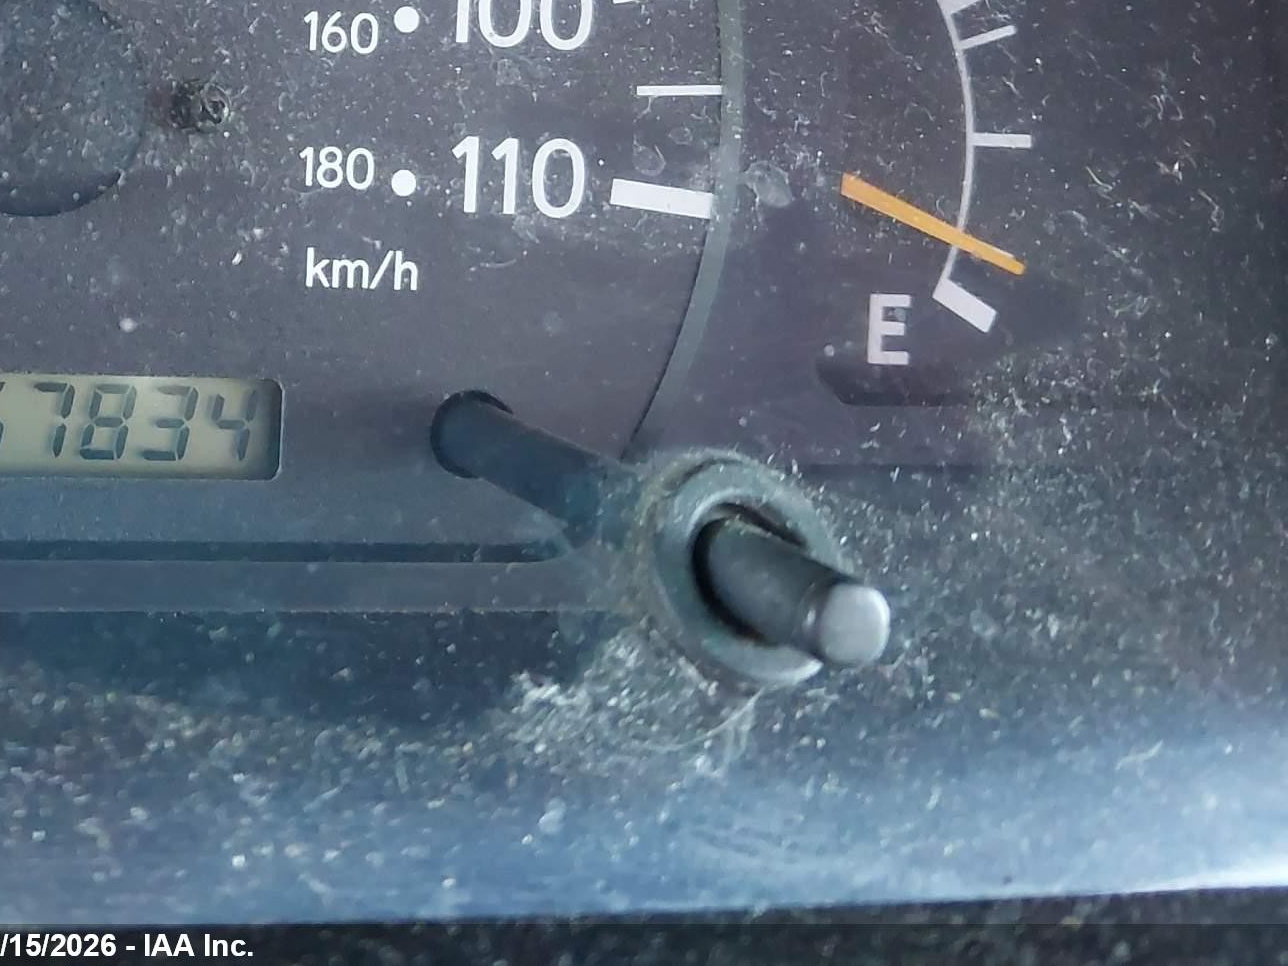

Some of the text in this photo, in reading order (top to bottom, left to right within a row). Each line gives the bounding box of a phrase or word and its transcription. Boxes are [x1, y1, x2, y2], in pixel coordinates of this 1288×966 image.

[304, 12, 378, 54] 160
[300, 147, 374, 190] 180
[452, 136, 585, 218] 110
[306, 247, 419, 291] km/h
[868, 294, 912, 364] E
